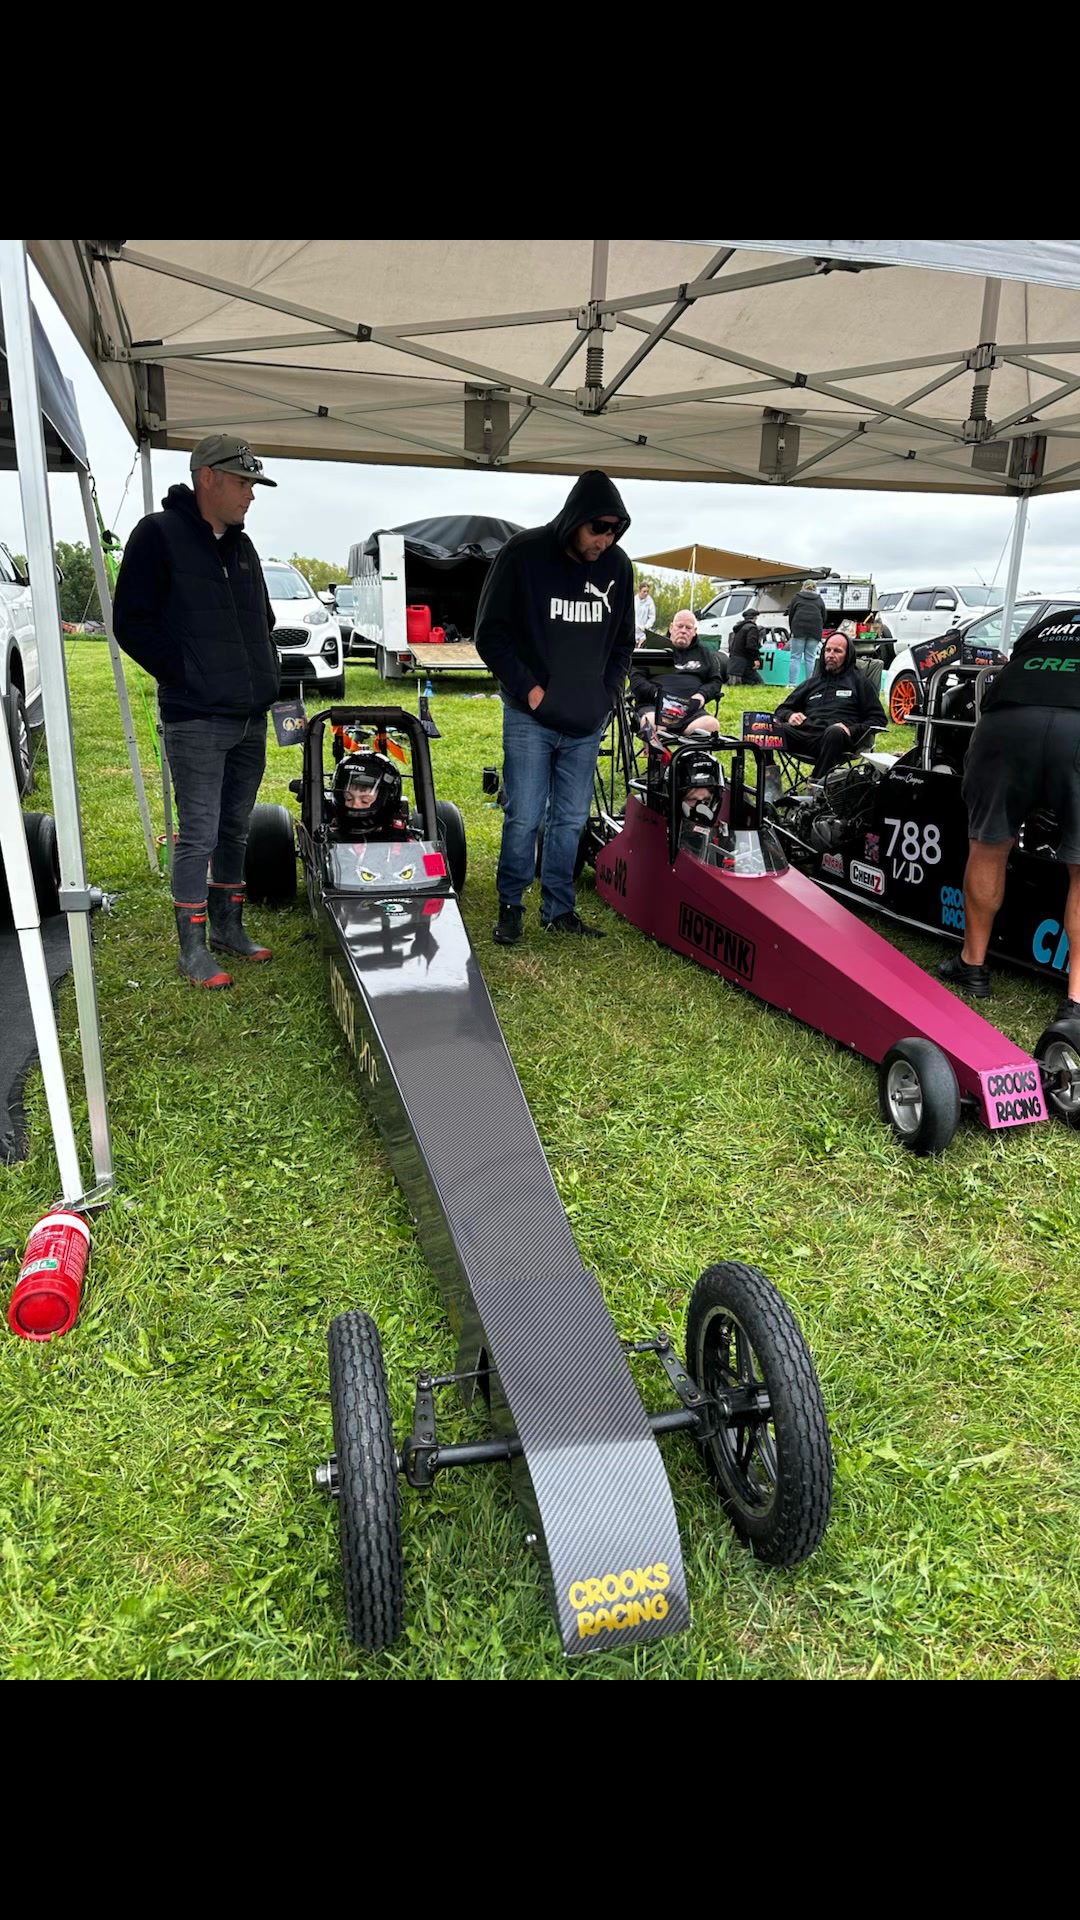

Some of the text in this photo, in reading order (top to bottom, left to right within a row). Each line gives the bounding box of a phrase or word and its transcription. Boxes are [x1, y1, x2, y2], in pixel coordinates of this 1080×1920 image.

[550, 597, 602, 622] PUMA
[884, 817, 941, 865] 788
[940, 885, 965, 909] CRO
[681, 904, 750, 974] HOTPNK
[987, 1070, 1037, 1097] CROOKS
[995, 1096, 1042, 1123] RACING
[568, 1562, 671, 1610] CROOKS
[577, 1593, 669, 1639] RACING
